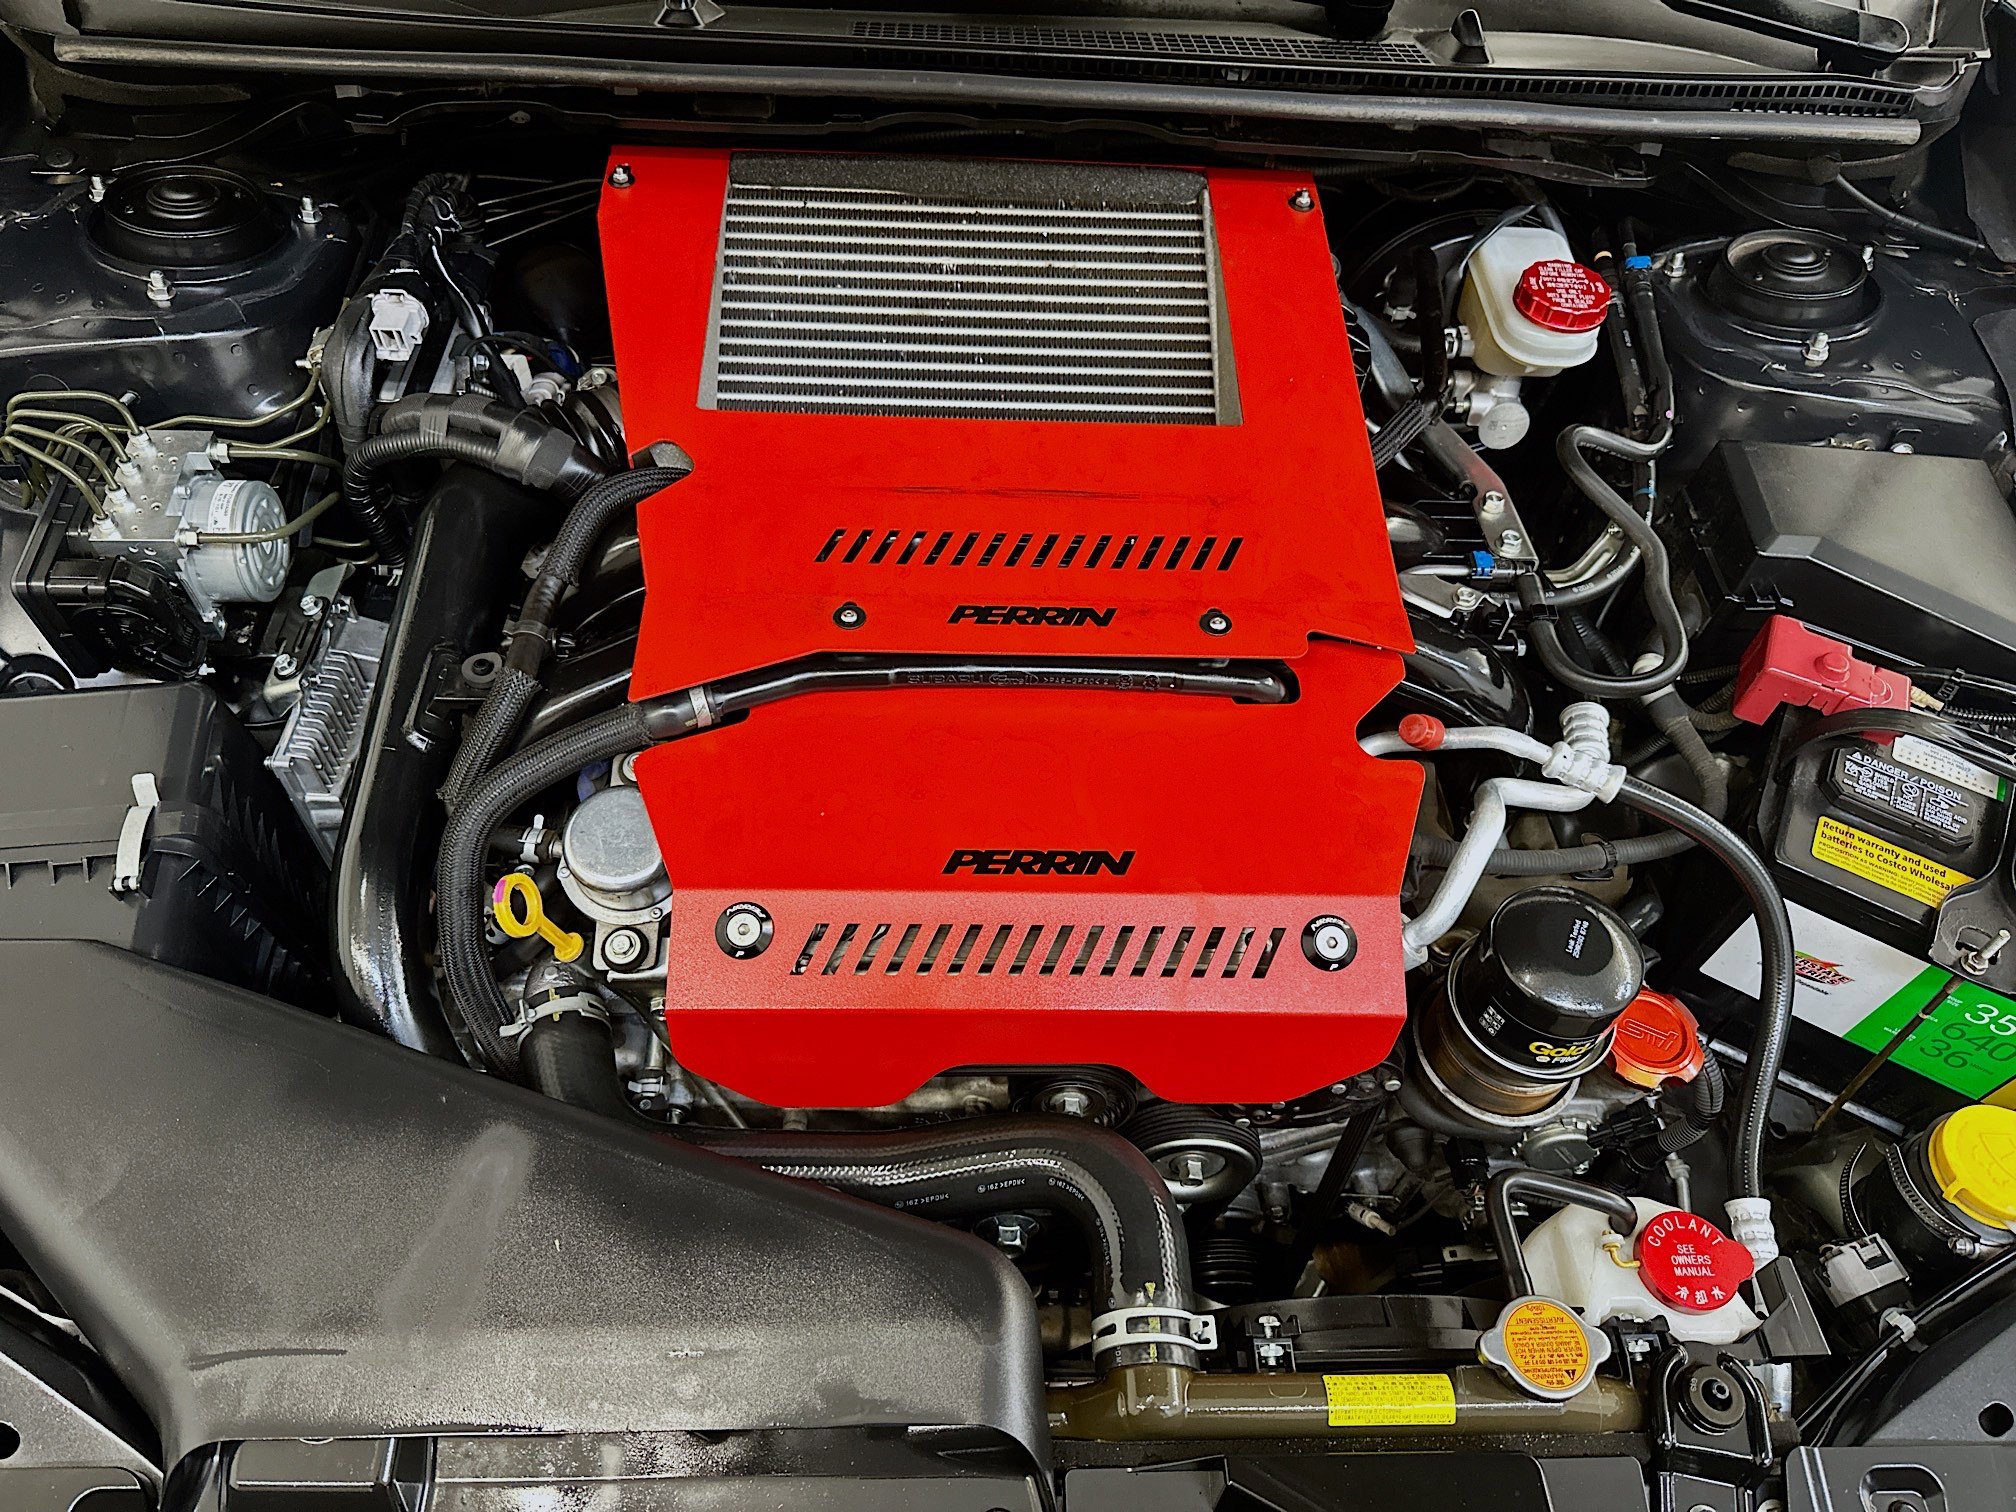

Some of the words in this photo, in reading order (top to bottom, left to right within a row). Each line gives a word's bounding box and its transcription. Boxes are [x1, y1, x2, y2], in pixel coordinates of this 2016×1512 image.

[947, 605, 1117, 627] PERRIN
[908, 674, 984, 684] SUBARU
[1863, 756, 1909, 780] DANGER
[1920, 778, 1962, 801] POISON
[1821, 831, 1862, 853] batteries
[1865, 849, 1874, 858] to
[1877, 855, 1907, 871] Costco
[1910, 869, 1956, 891] Wholesal
[1822, 821, 1855, 839] Return
[1858, 834, 1900, 859] warranty
[1902, 855, 1921, 866] and
[1923, 863, 1947, 877] used
[941, 850, 1136, 876] PERRIN
[1795, 955, 1850, 984] ERSTATE
[1529, 1042, 1591, 1056] Gold
[1920, 1039, 1968, 1068] 36
[1941, 1023, 2016, 1062] 640
[1648, 1216, 1724, 1247] COOLANT
[1671, 1255, 1712, 1265] OWNERS
[1676, 1244, 1696, 1254] SEE
[1674, 1266, 1715, 1276] MANUAL
[1675, 1285, 1726, 1305] 冷却水
